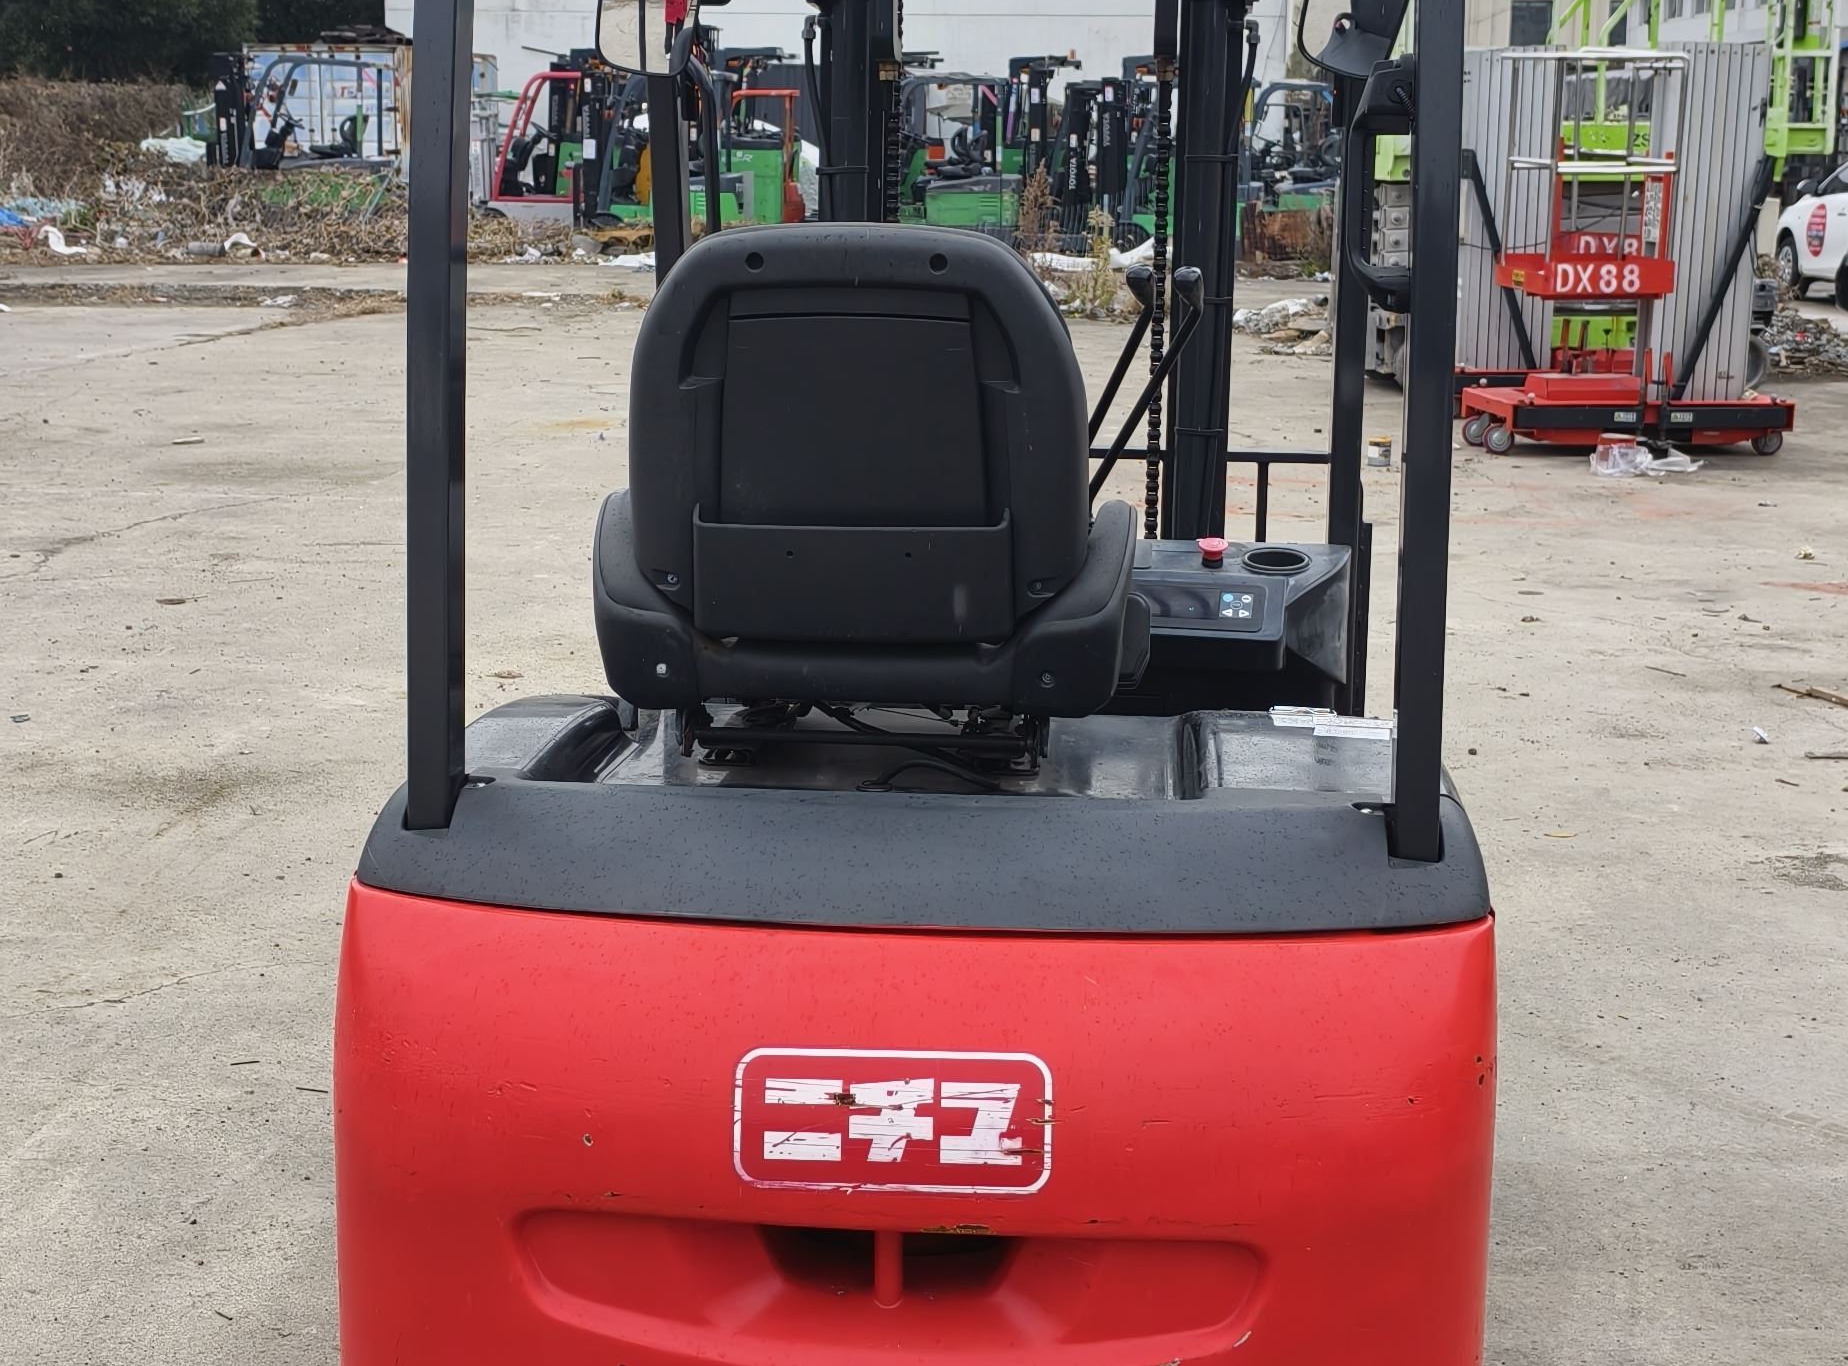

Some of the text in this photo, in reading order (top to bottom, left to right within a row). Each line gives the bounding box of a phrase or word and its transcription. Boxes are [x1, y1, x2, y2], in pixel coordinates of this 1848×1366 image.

[1102, 111, 1111, 147] TOYOTA
[1068, 156, 1077, 190] TOYOTA
[1579, 235, 1639, 255] DX8
[1555, 263, 1641, 293] DX88
